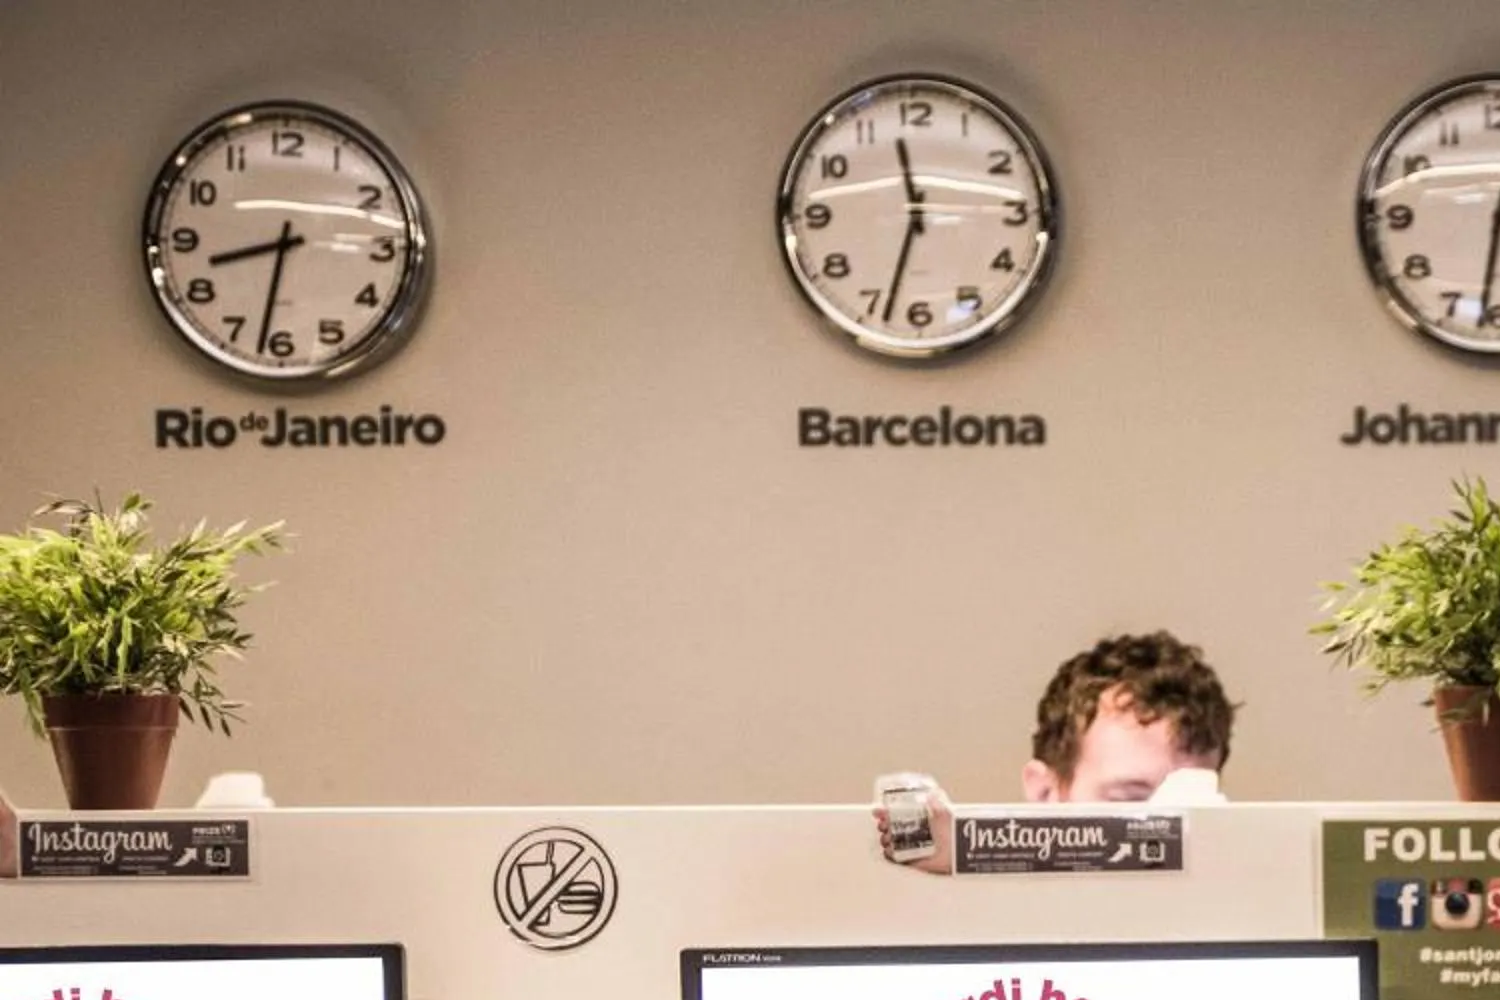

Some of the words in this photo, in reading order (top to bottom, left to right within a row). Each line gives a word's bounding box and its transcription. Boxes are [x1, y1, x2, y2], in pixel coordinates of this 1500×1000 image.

[900, 103, 932, 126] 12
[961, 113, 967, 137] 1
[857, 120, 874, 144] 11
[1439, 122, 1459, 146] 11
[273, 133, 303, 156] 12
[227, 146, 245, 171] 11
[334, 147, 340, 171] 1
[821, 154, 848, 178] 10
[988, 152, 1012, 174] 2
[190, 180, 216, 205] 10
[358, 186, 381, 210] 2
[805, 204, 831, 228] 9
[1003, 202, 1028, 226] 3
[1387, 205, 1414, 229] 9
[172, 228, 198, 252] 9
[370, 237, 394, 261] 3
[823, 253, 850, 277] 8
[990, 248, 1014, 271] 4
[1404, 255, 1431, 279] 8
[187, 279, 215, 303] 8
[355, 284, 378, 307] 4
[860, 291, 881, 315] 7
[908, 303, 932, 326] 6
[1440, 292, 1462, 316] 7
[223, 318, 245, 342] 7
[319, 321, 344, 344] 5
[269, 332, 294, 357] 6
[155, 407, 236, 448] Rio
[240, 410, 269, 431] de
[261, 405, 446, 448] Janeiro
[798, 406, 1046, 447] Barcelona
[28, 822, 173, 865] Instagram
[963, 819, 1108, 861] Instagram
